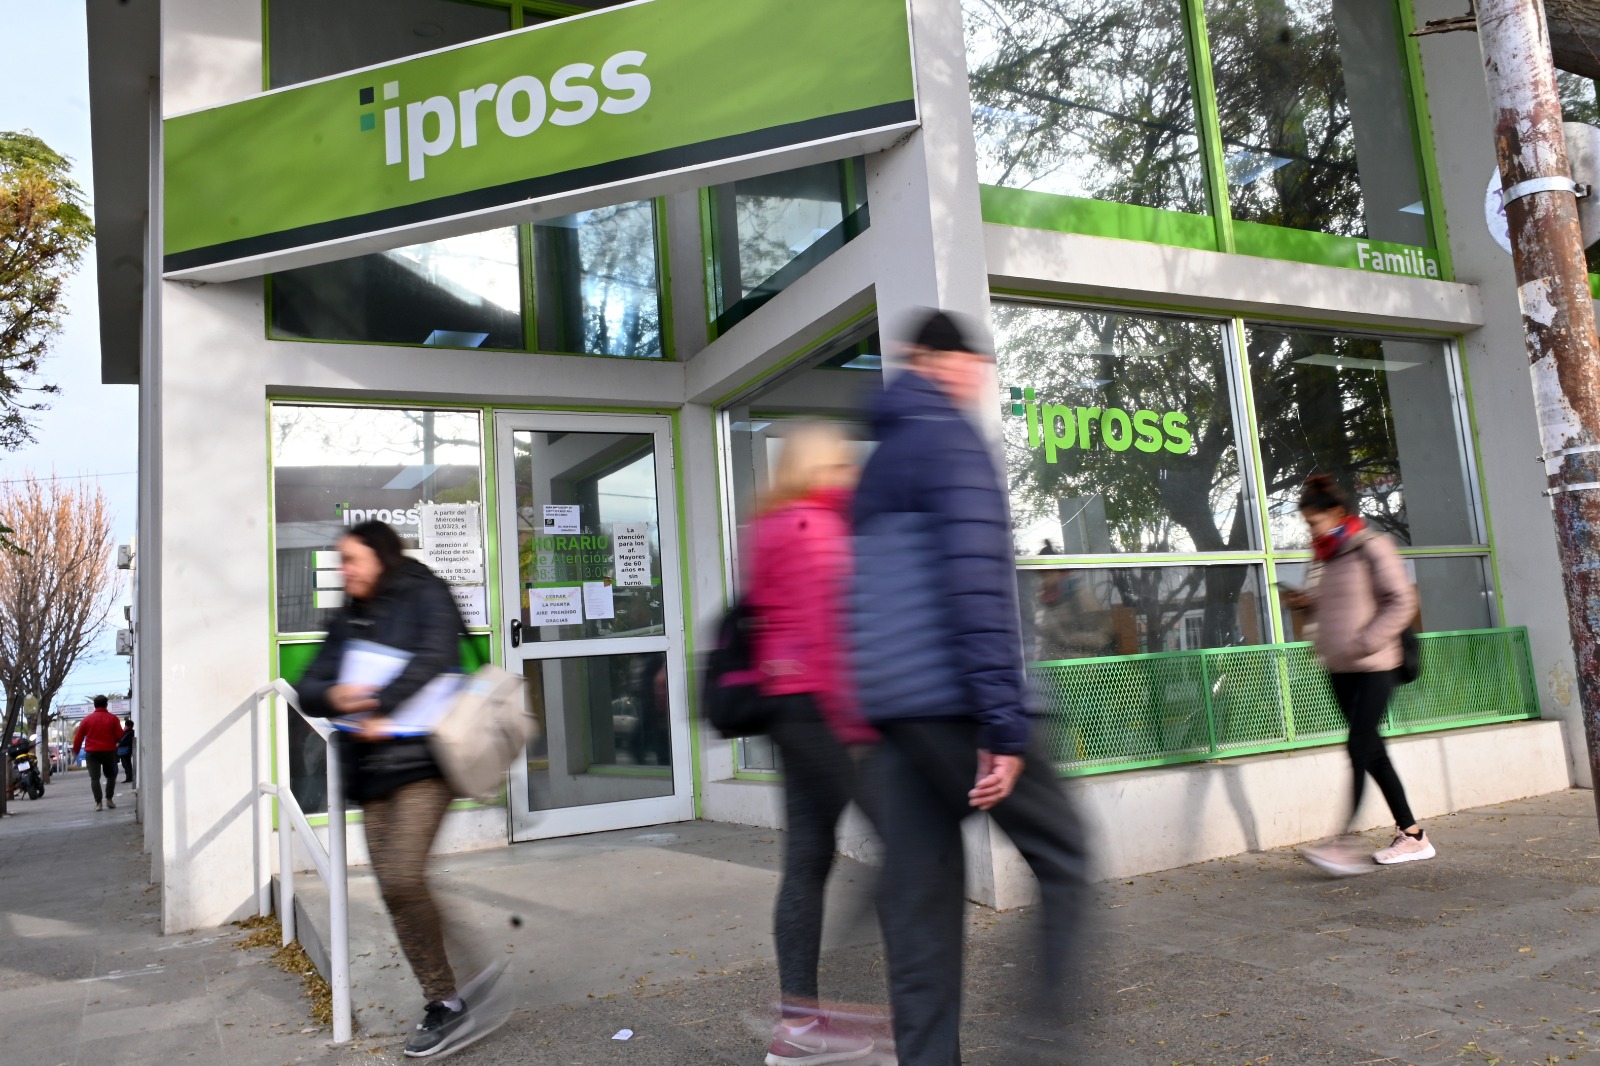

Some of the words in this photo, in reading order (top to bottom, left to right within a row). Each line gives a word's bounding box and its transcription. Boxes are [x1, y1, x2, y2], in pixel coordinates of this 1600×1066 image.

[383, 50, 651, 182] ipross
[1356, 242, 1438, 277] Familia
[1024, 387, 1192, 463] ipross
[531, 536, 609, 551] HORARIO
[552, 551, 610, 565] Atención
